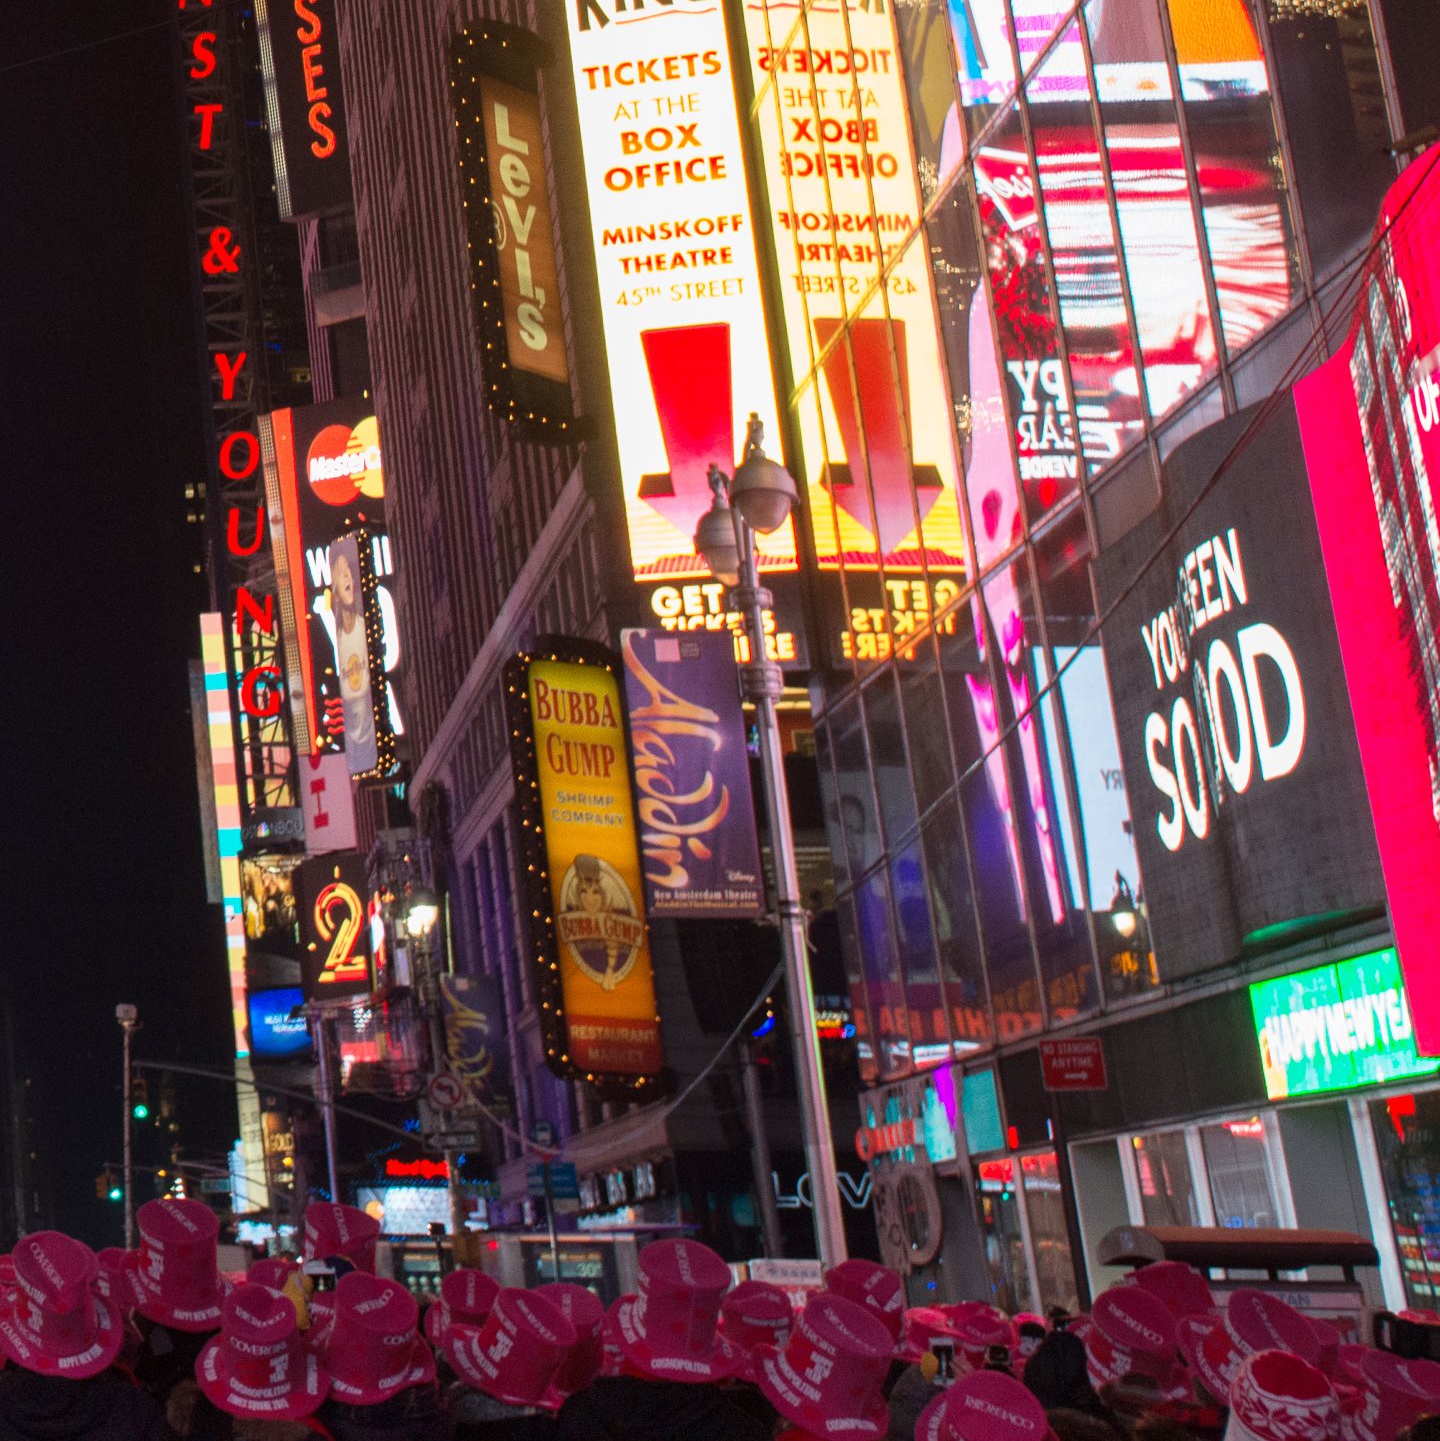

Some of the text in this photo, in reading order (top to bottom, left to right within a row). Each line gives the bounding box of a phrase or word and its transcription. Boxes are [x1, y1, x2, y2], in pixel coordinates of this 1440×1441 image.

[582, 49, 723, 92] TICKETS
[613, 91, 701, 124] AT THE
[621, 123, 702, 157] BOX
[604, 155, 727, 193] OFFICE
[601, 213, 745, 247] MINSKOFF
[620, 245, 734, 276] THEATRE
[670, 276, 746, 301] STREET
[214, 351, 282, 718] YOUNG
[651, 584, 725, 618] GET
[533, 677, 619, 729] BUBBA
[545, 732, 616, 779] GUMP
[556, 789, 616, 807] SHRIMP
[551, 808, 626, 828] COMPANY
[28, 1241, 68, 1292] COVERGIRL
[229, 1336, 288, 1357] COVERGIRL
[650, 1357, 713, 1376] COSMOPOLITAN
